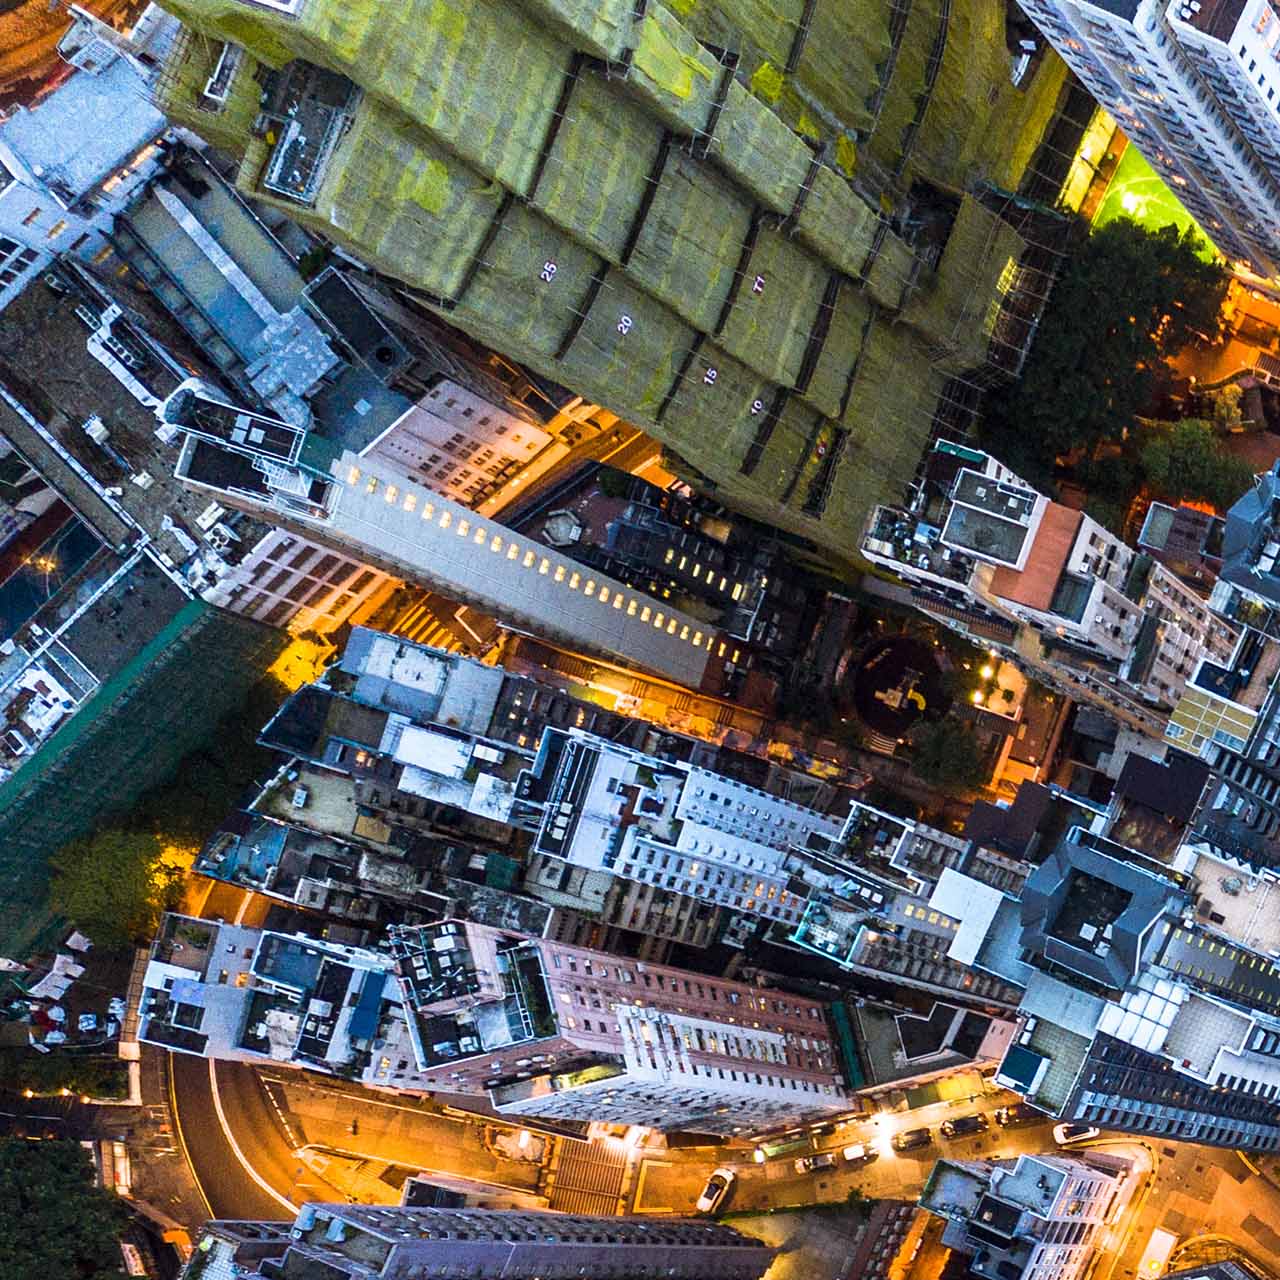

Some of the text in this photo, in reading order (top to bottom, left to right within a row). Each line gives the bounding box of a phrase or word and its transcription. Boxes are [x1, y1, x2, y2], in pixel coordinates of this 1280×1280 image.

[540, 261, 558, 283] 25
[617, 315, 634, 335] 20
[703, 367, 718, 386] 15
[751, 399, 763, 416] 10
